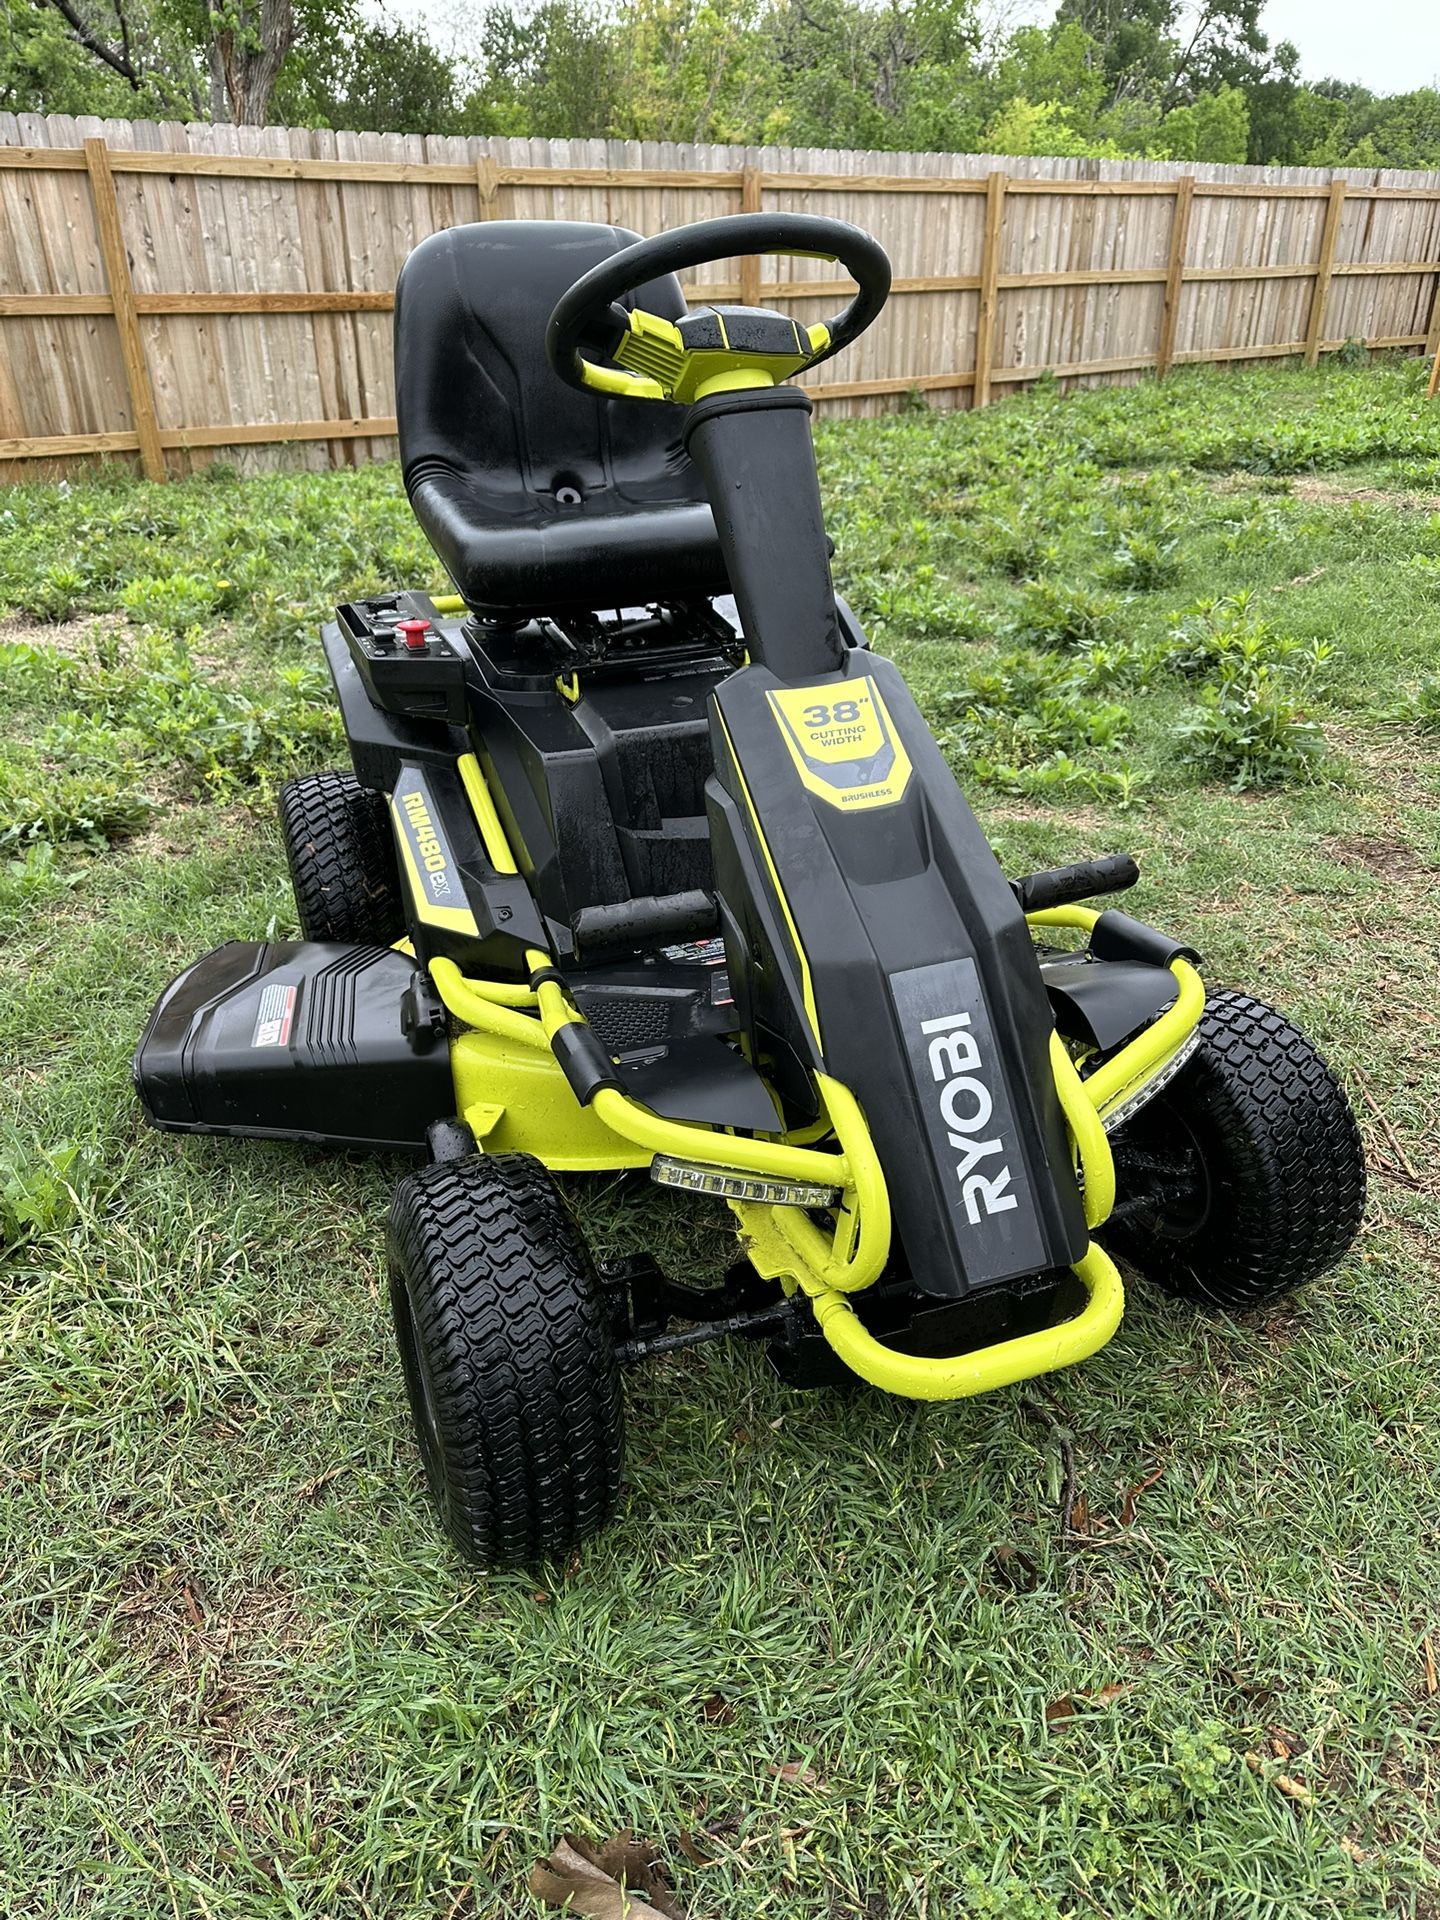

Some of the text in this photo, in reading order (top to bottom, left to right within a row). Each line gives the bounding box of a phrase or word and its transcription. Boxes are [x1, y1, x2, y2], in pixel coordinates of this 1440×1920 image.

[811, 726, 866, 740] CUTTING
[821, 735, 862, 747] WIDTH
[842, 789, 892, 802] BRUSHLESS
[920, 1011, 1019, 1225] RYOBI
